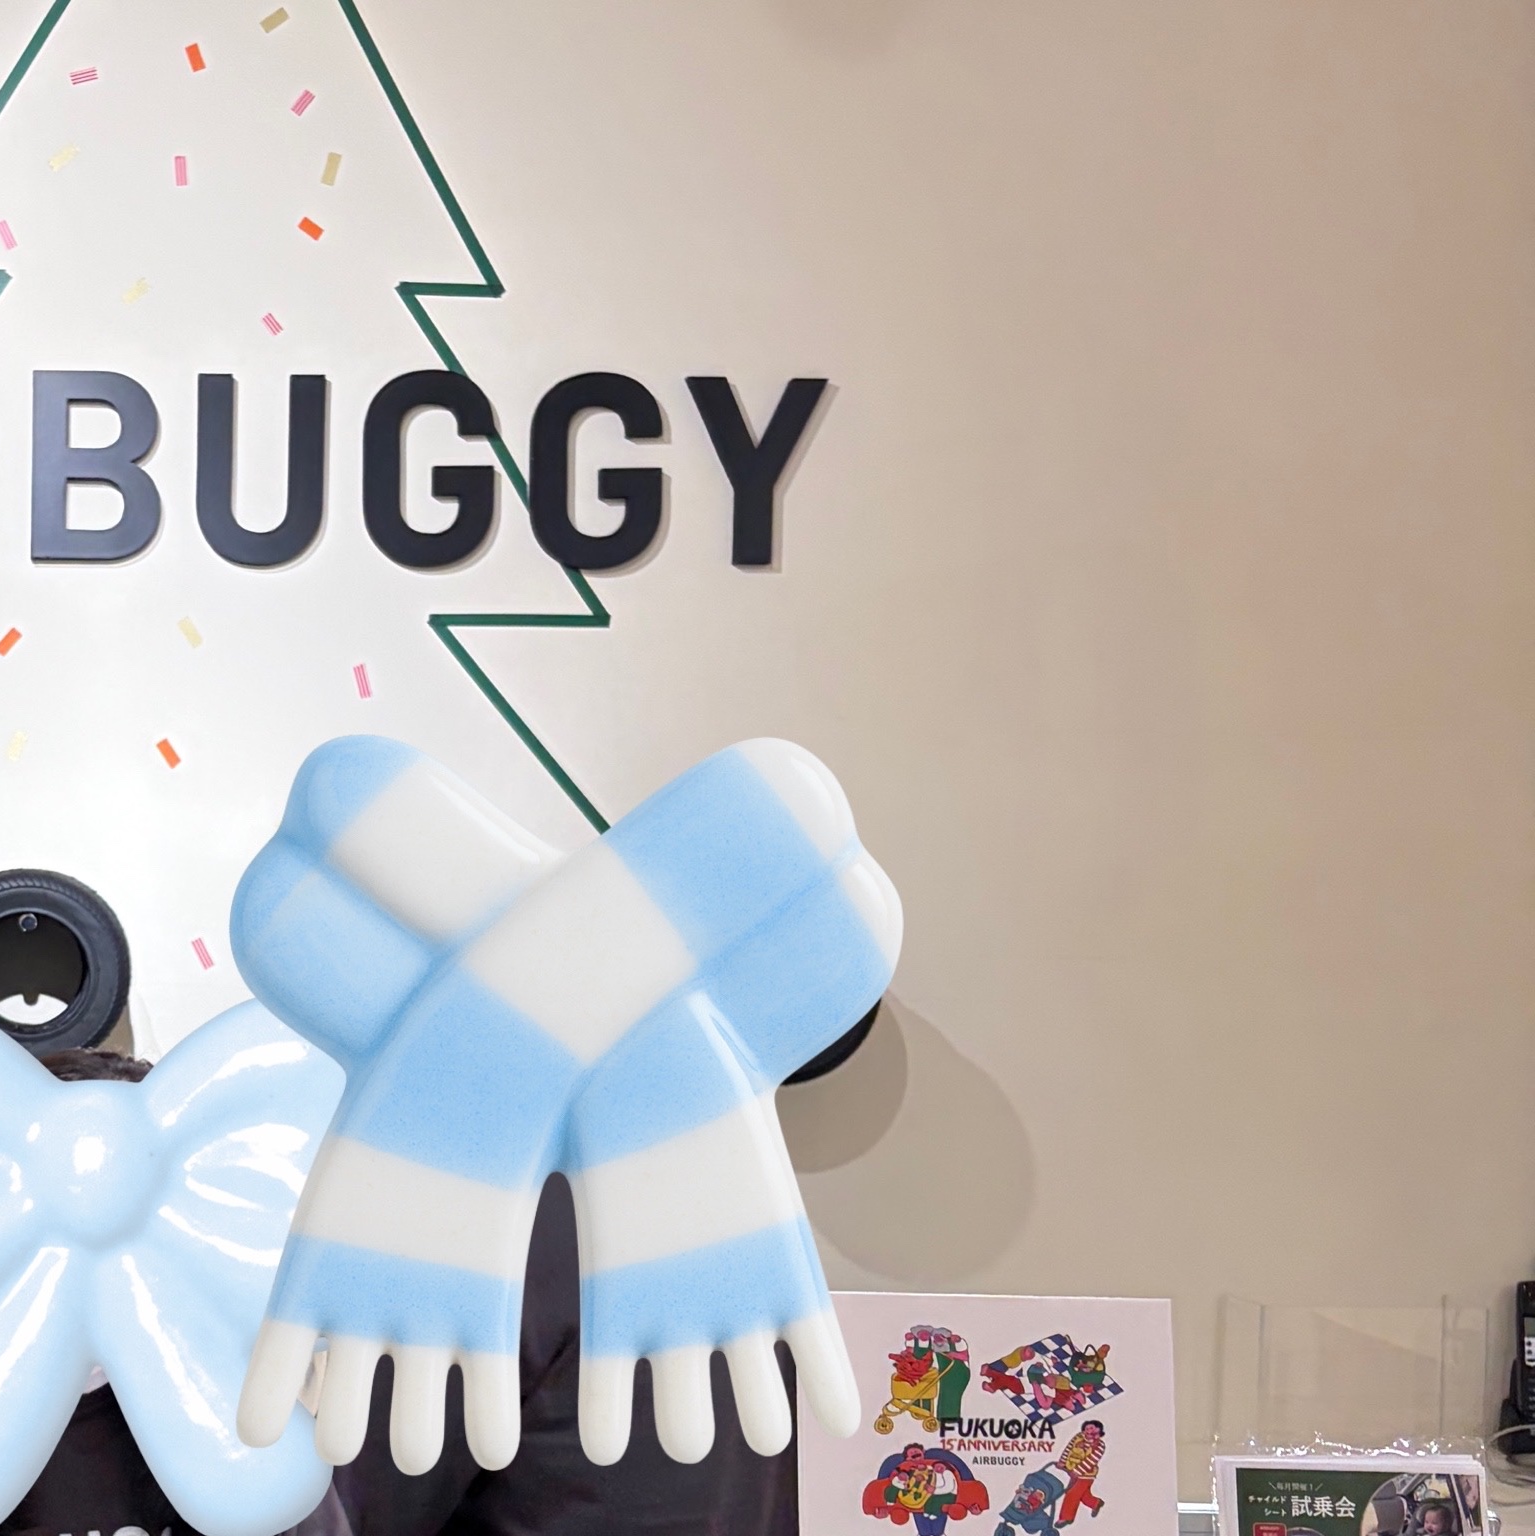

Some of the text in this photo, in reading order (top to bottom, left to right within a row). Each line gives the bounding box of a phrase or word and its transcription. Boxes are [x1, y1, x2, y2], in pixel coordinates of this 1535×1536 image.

[940, 1418, 1056, 1439] FUKUOKA
[973, 1456, 1026, 1466] AIRBUGGY
[1264, 1508, 1287, 1517] シート
[1290, 1495, 1356, 1518] 試乗会
